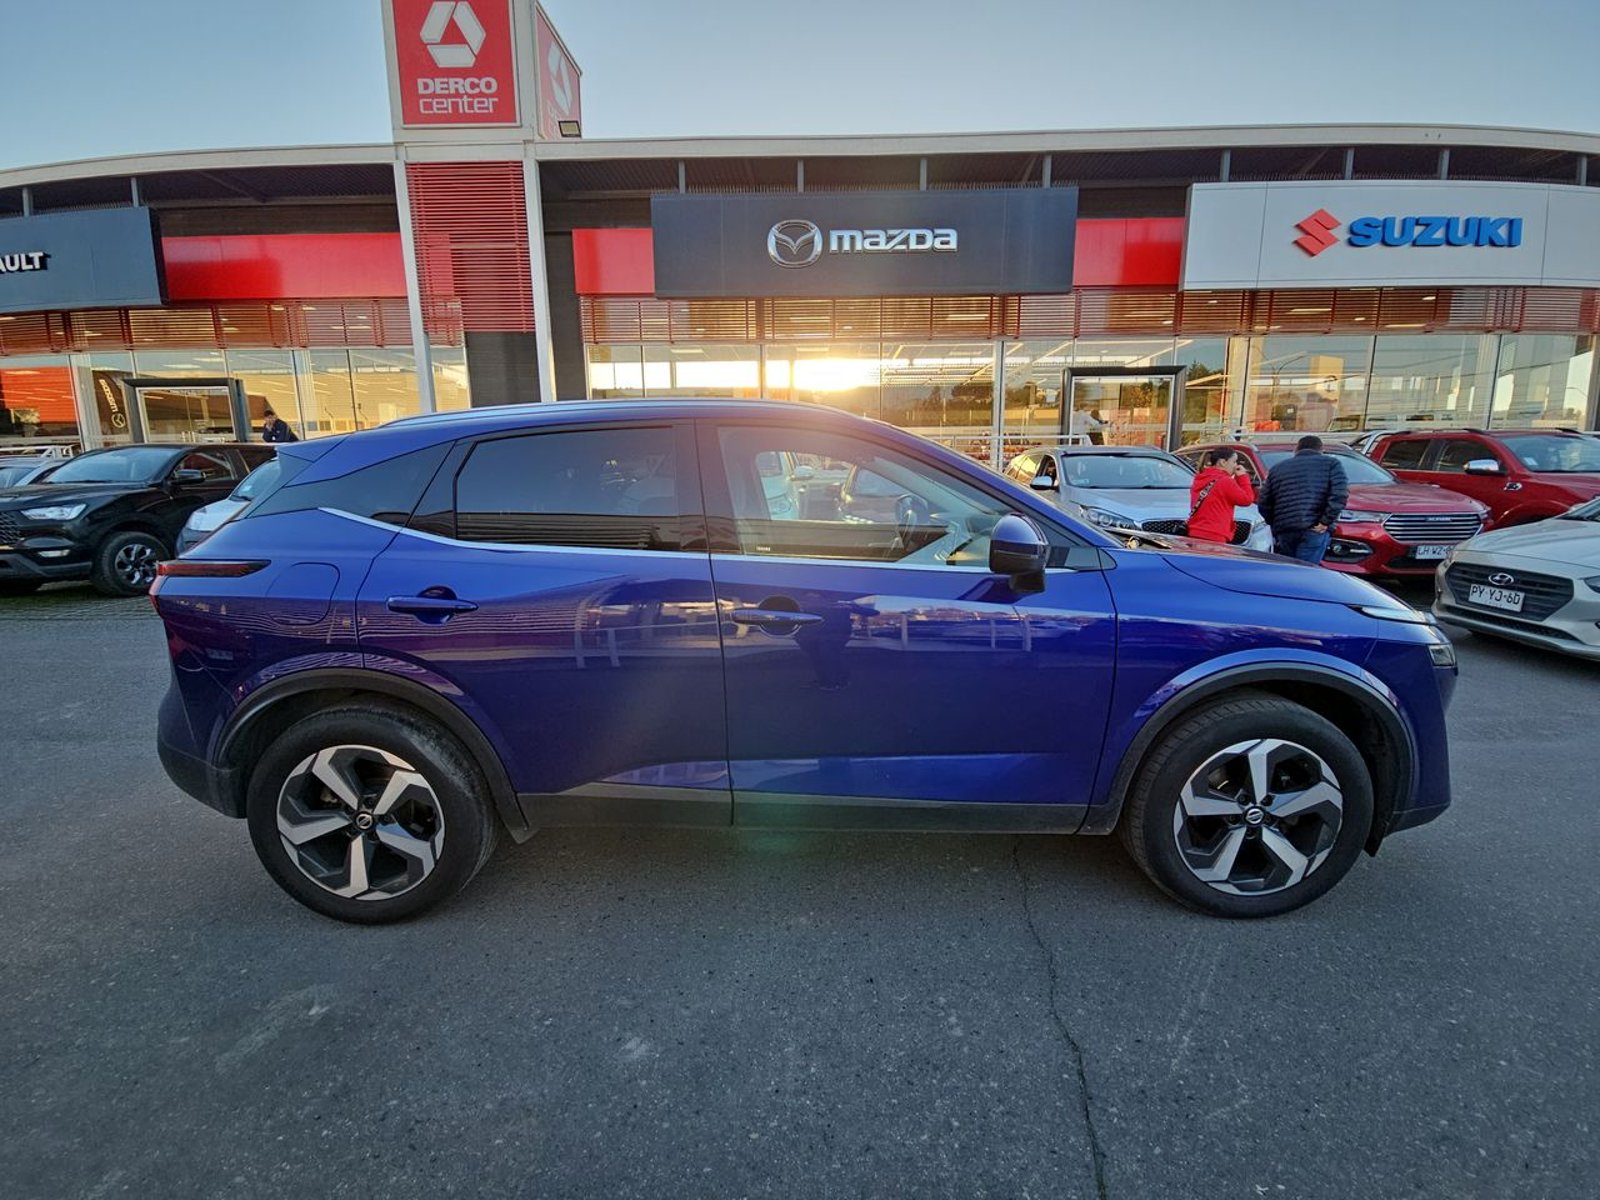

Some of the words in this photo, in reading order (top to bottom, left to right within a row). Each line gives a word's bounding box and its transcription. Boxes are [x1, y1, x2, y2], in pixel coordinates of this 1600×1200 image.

[417, 77, 498, 95] DERCO
[419, 95, 499, 114] center
[829, 228, 958, 252] mazda
[1348, 216, 1523, 247] SUZUKI
